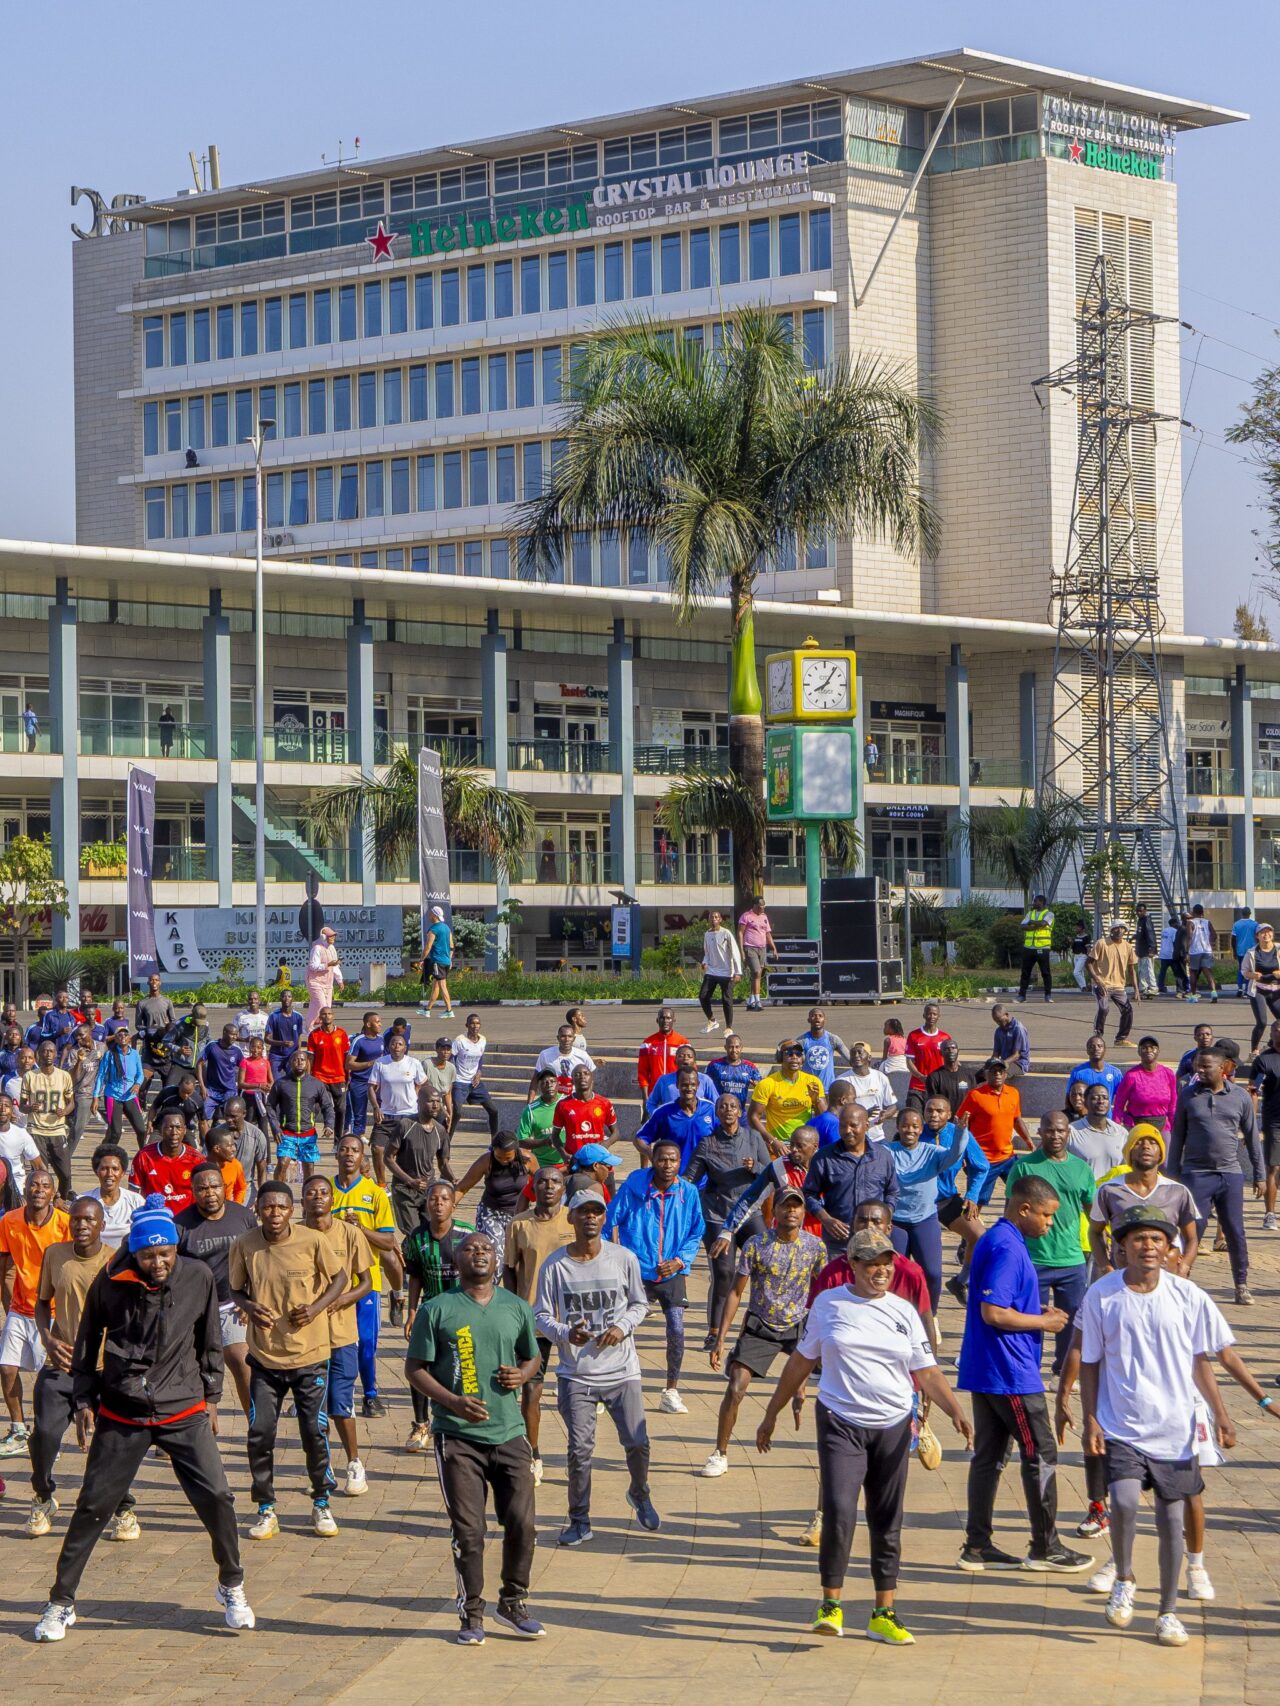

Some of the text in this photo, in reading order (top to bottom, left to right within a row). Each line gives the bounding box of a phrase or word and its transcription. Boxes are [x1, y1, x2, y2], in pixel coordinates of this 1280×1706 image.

[1050, 120, 1091, 137] ROOFTOP
[1094, 130, 1112, 143] BAR
[1123, 136, 1177, 155] RESTAURANT
[593, 151, 809, 208] CRYSTAL LOUNGE
[1085, 139, 1160, 180] Heineken
[596, 206, 656, 227] ROOFTOP
[664, 201, 692, 216] BAR
[718, 181, 811, 207] RESTAURANT
[408, 202, 591, 258] Heineken
[235, 911, 294, 925] KIALI
[563, 1289, 617, 1312] RUN
[456, 1325, 479, 1394] RWANDA
